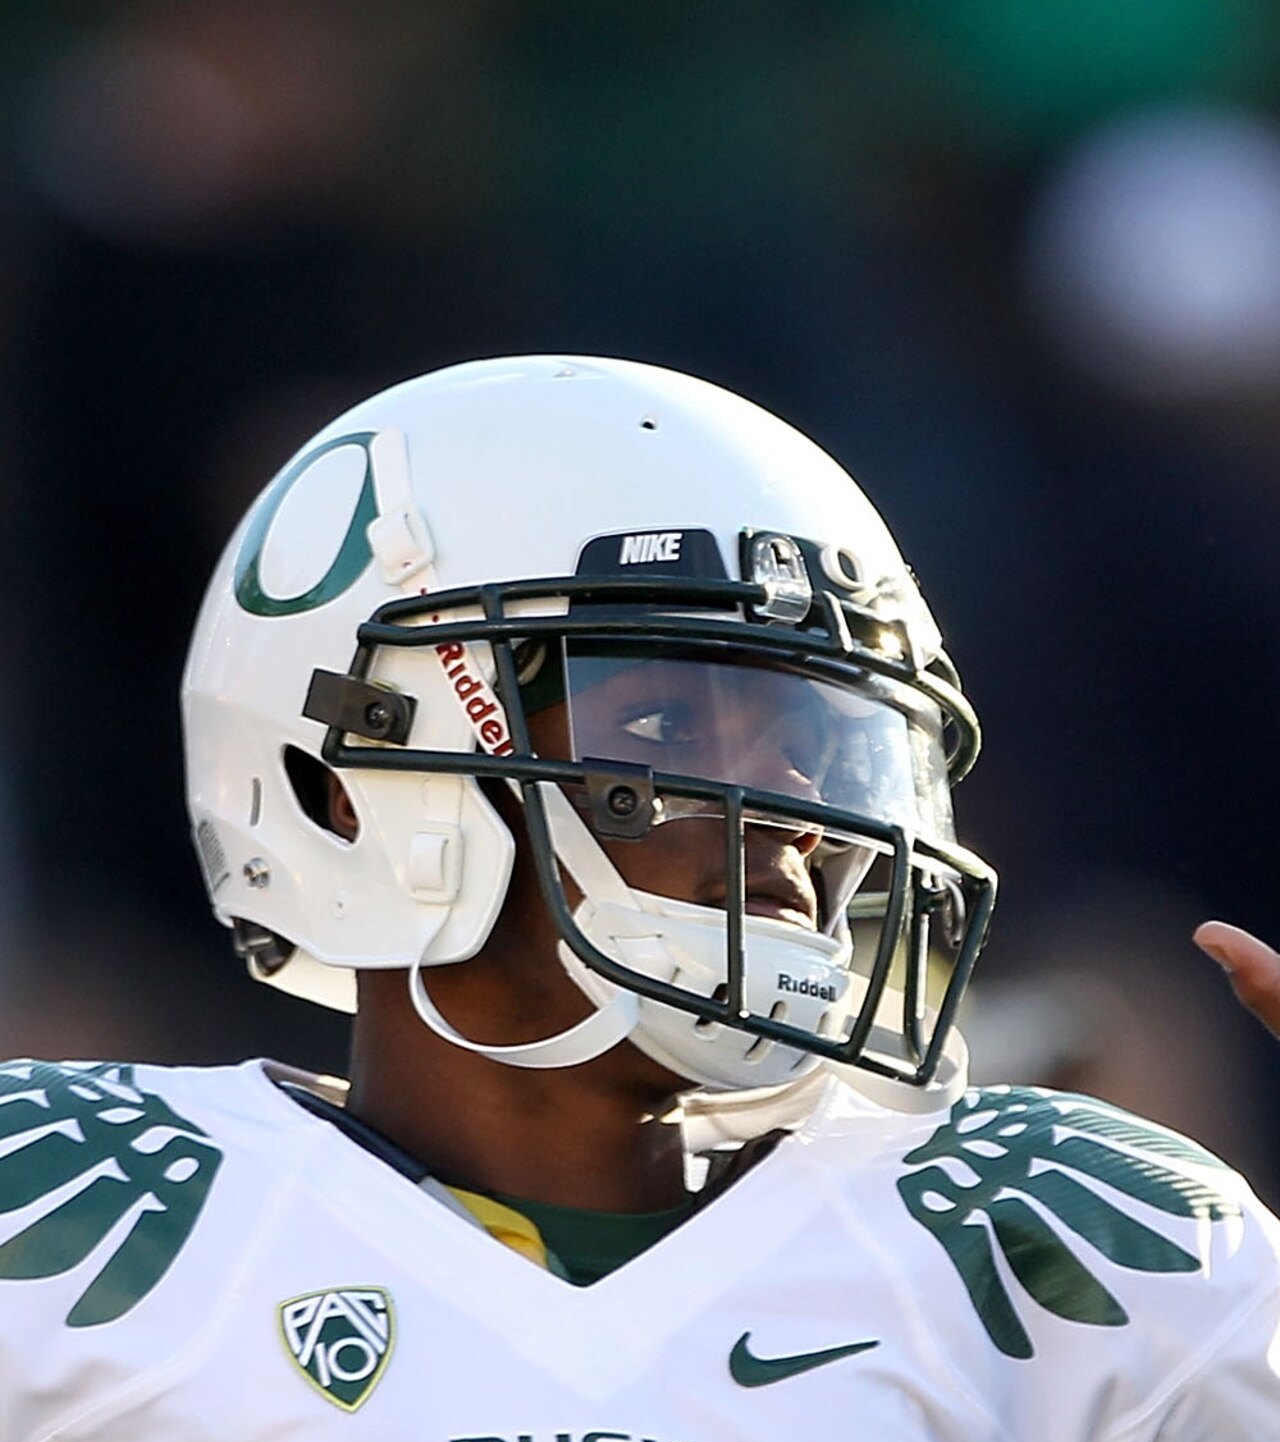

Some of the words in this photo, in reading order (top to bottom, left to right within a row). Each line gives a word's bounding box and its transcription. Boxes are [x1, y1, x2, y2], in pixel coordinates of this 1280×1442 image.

[620, 533, 683, 565] NIKE
[282, 1291, 389, 1367] PAC
[314, 1336, 379, 1388] 10
